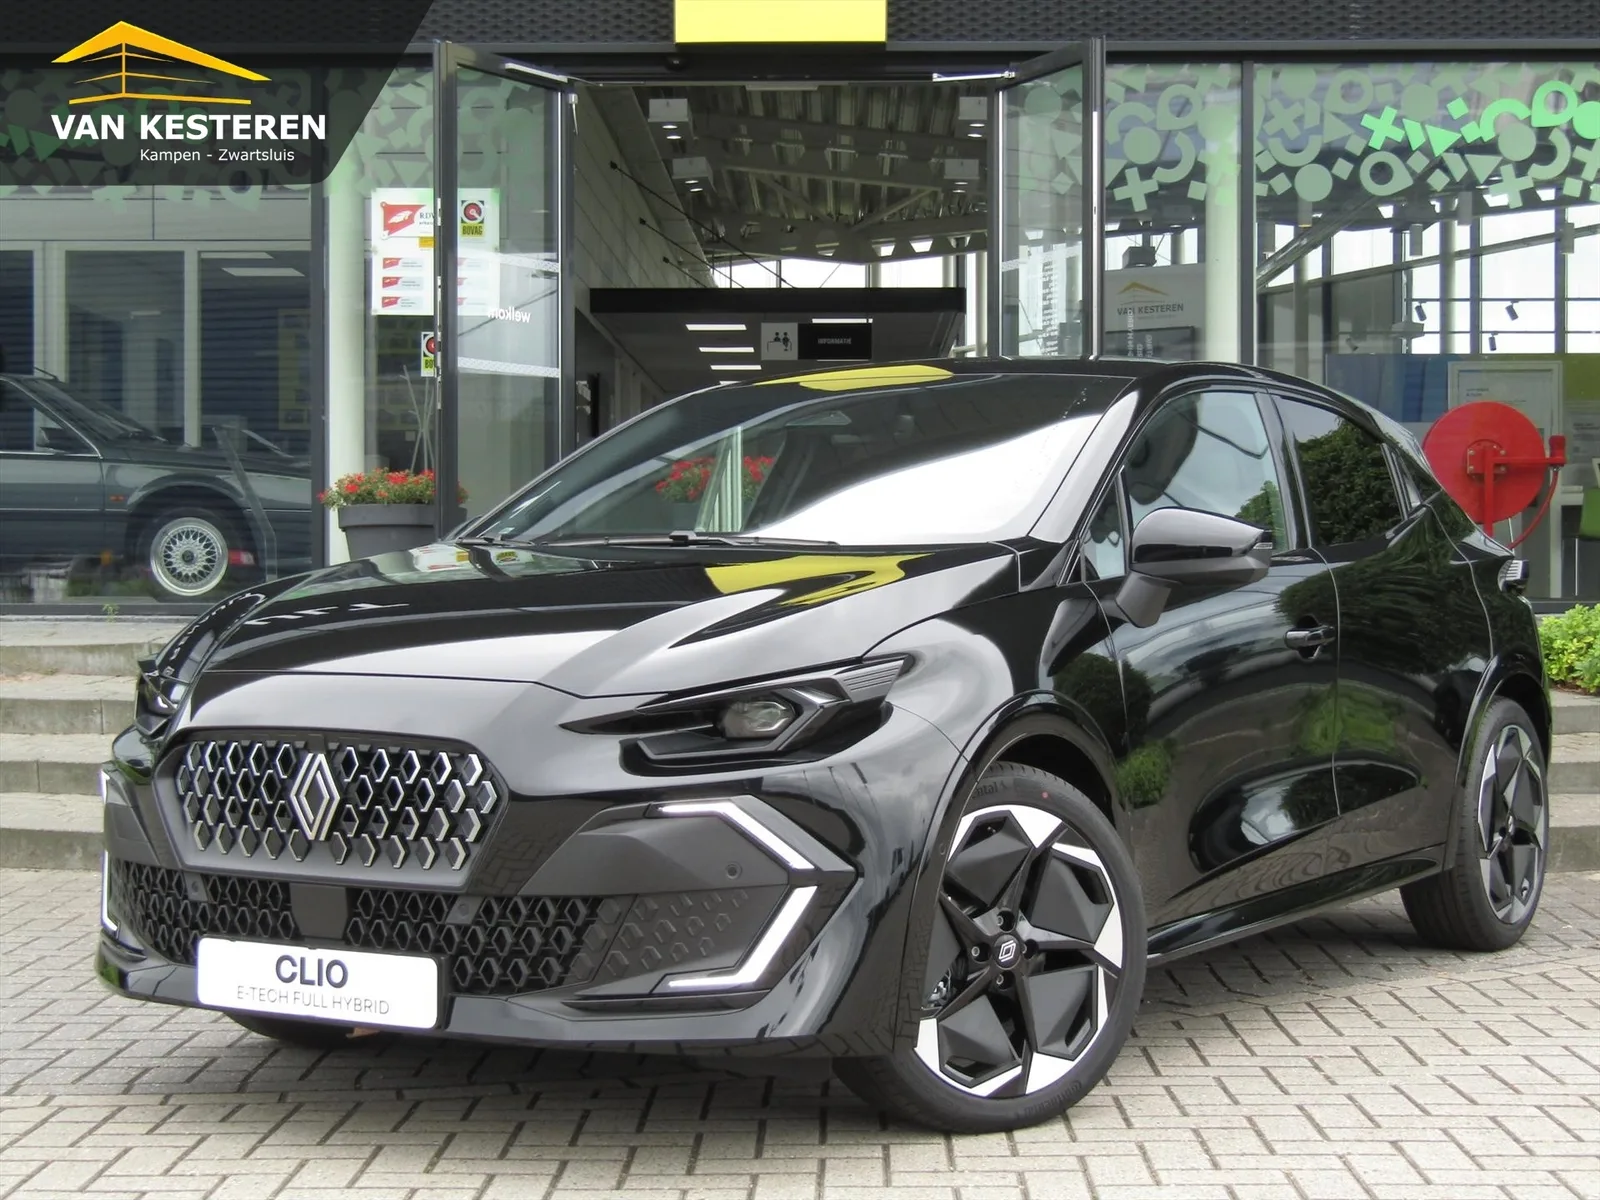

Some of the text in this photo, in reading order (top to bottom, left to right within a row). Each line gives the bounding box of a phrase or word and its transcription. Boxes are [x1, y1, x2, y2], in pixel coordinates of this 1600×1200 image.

[462, 225, 483, 235] BOVAG
[1138, 303, 1184, 314] KESTEREN
[275, 954, 349, 989] CLIO
[237, 985, 390, 1015] E-TECH FULL HYBRID
